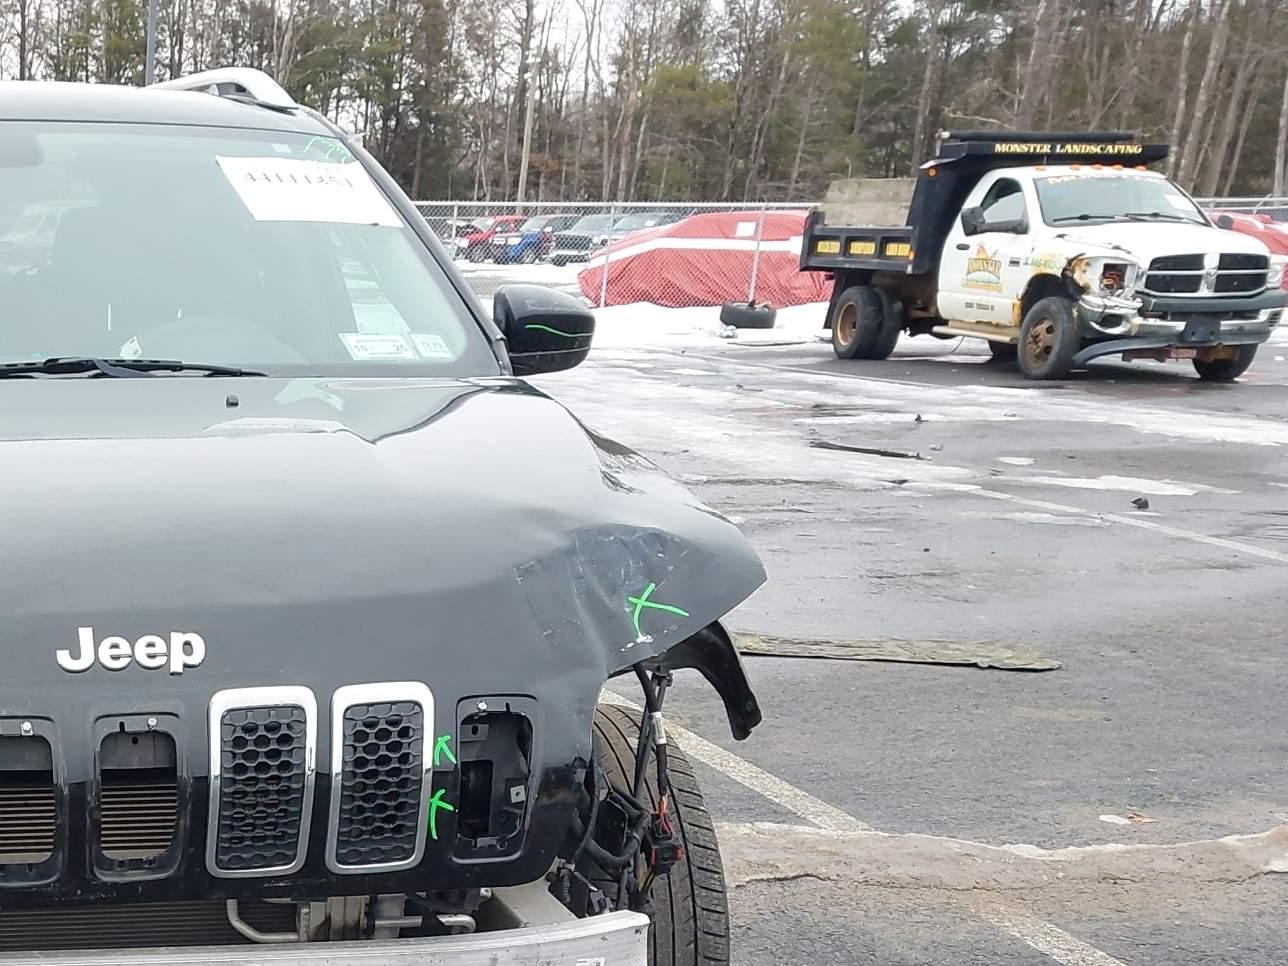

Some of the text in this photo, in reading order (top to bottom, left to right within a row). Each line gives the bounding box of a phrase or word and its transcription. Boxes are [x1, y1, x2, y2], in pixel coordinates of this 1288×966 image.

[994, 143, 1143, 154] MONSTER LANDSCAPING
[56, 626, 206, 676] Jeep
